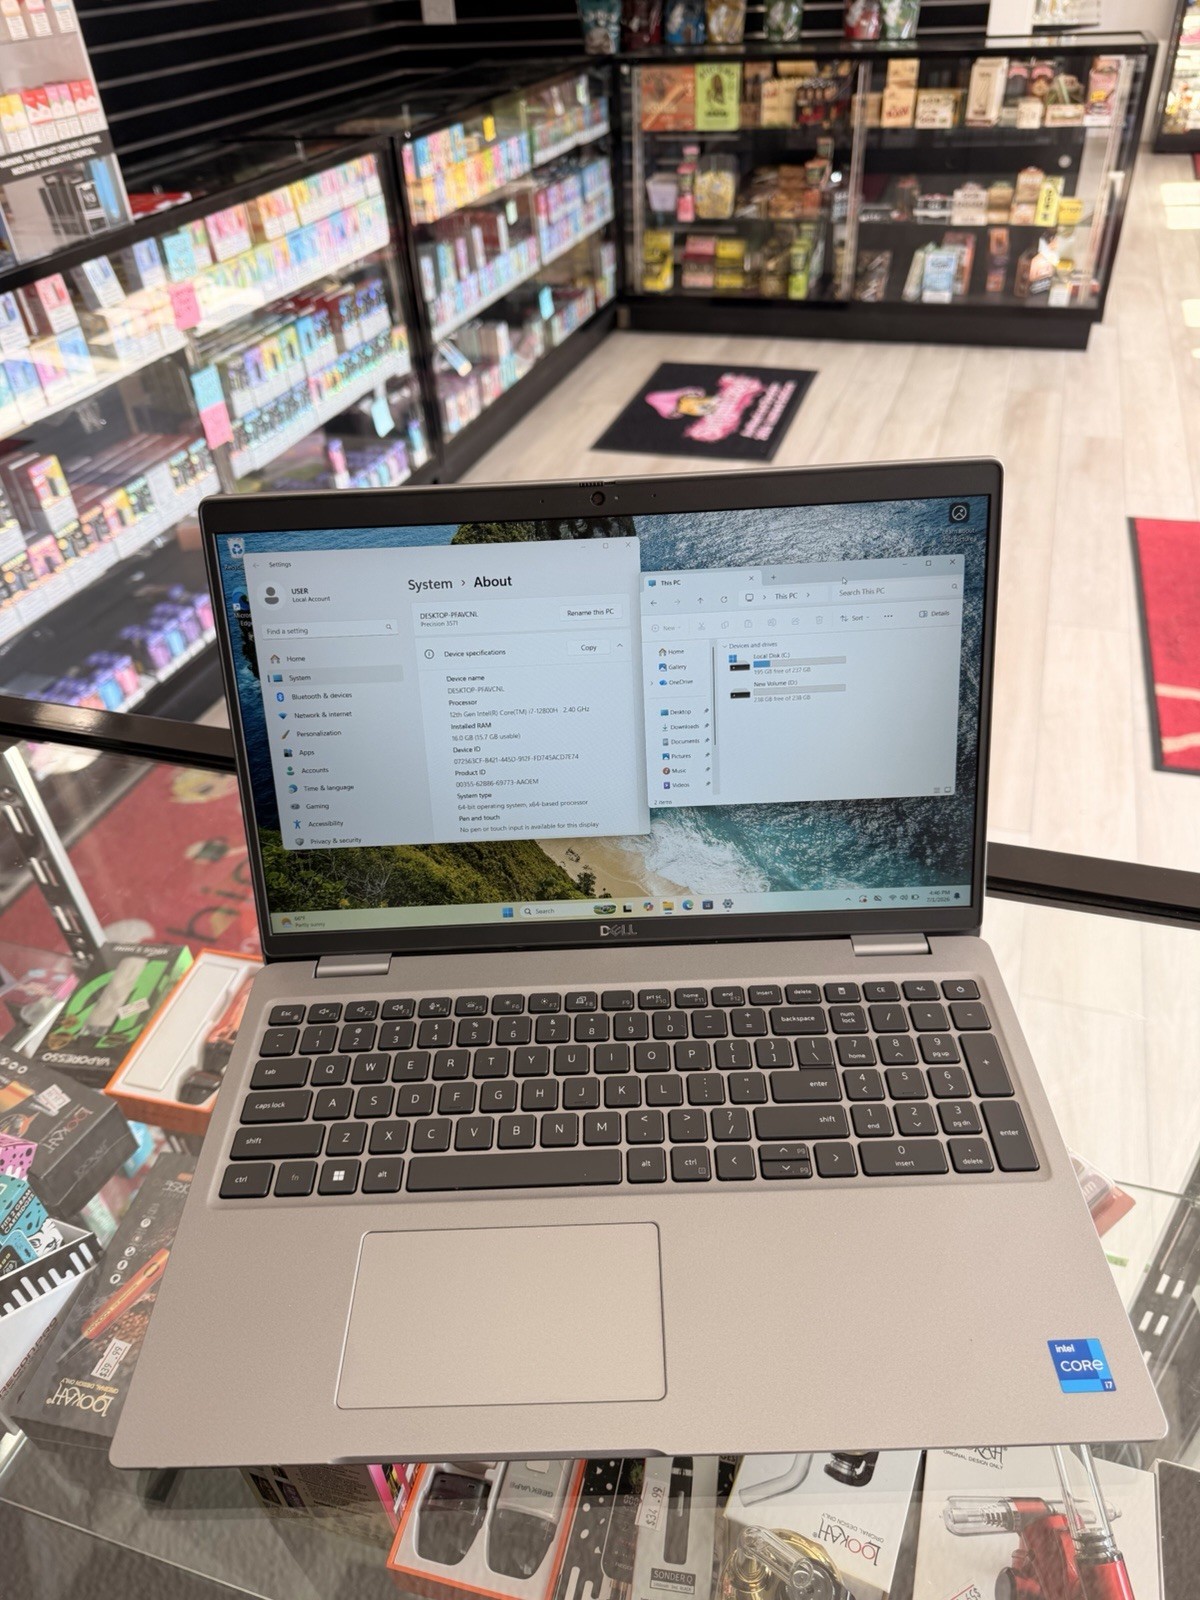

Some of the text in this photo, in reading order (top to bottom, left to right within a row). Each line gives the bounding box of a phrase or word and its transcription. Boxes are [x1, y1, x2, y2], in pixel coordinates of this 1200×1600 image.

[408, 576, 512, 593] System About
[567, 609, 592, 617] Rename
[287, 627, 308, 635] setting
[581, 644, 597, 652] Copy
[466, 649, 506, 658] specifications
[477, 803, 505, 811] operating
[535, 907, 554, 916] Search
[600, 924, 638, 937] DELL
[781, 1015, 815, 1023] backspace
[42, 1052, 110, 1067] VAPORESSO
[255, 1101, 285, 1111] caps lock
[245, 1137, 262, 1145] shift
[234, 1175, 248, 1184] ctrl
[1, 1218, 11, 1229] FITS
[16, 1190, 32, 1210] GRAM
[4, 1193, 35, 1233] CARTRIDGES
[1055, 1344, 1075, 1353] intel
[968, 1457, 988, 1466] DESIGN
[509, 1482, 554, 1498] GEEKVAPE
[821, 1512, 884, 1543] ORIGINAL DESIGN ONLY
[654, 1570, 693, 1583] SONDER Q
